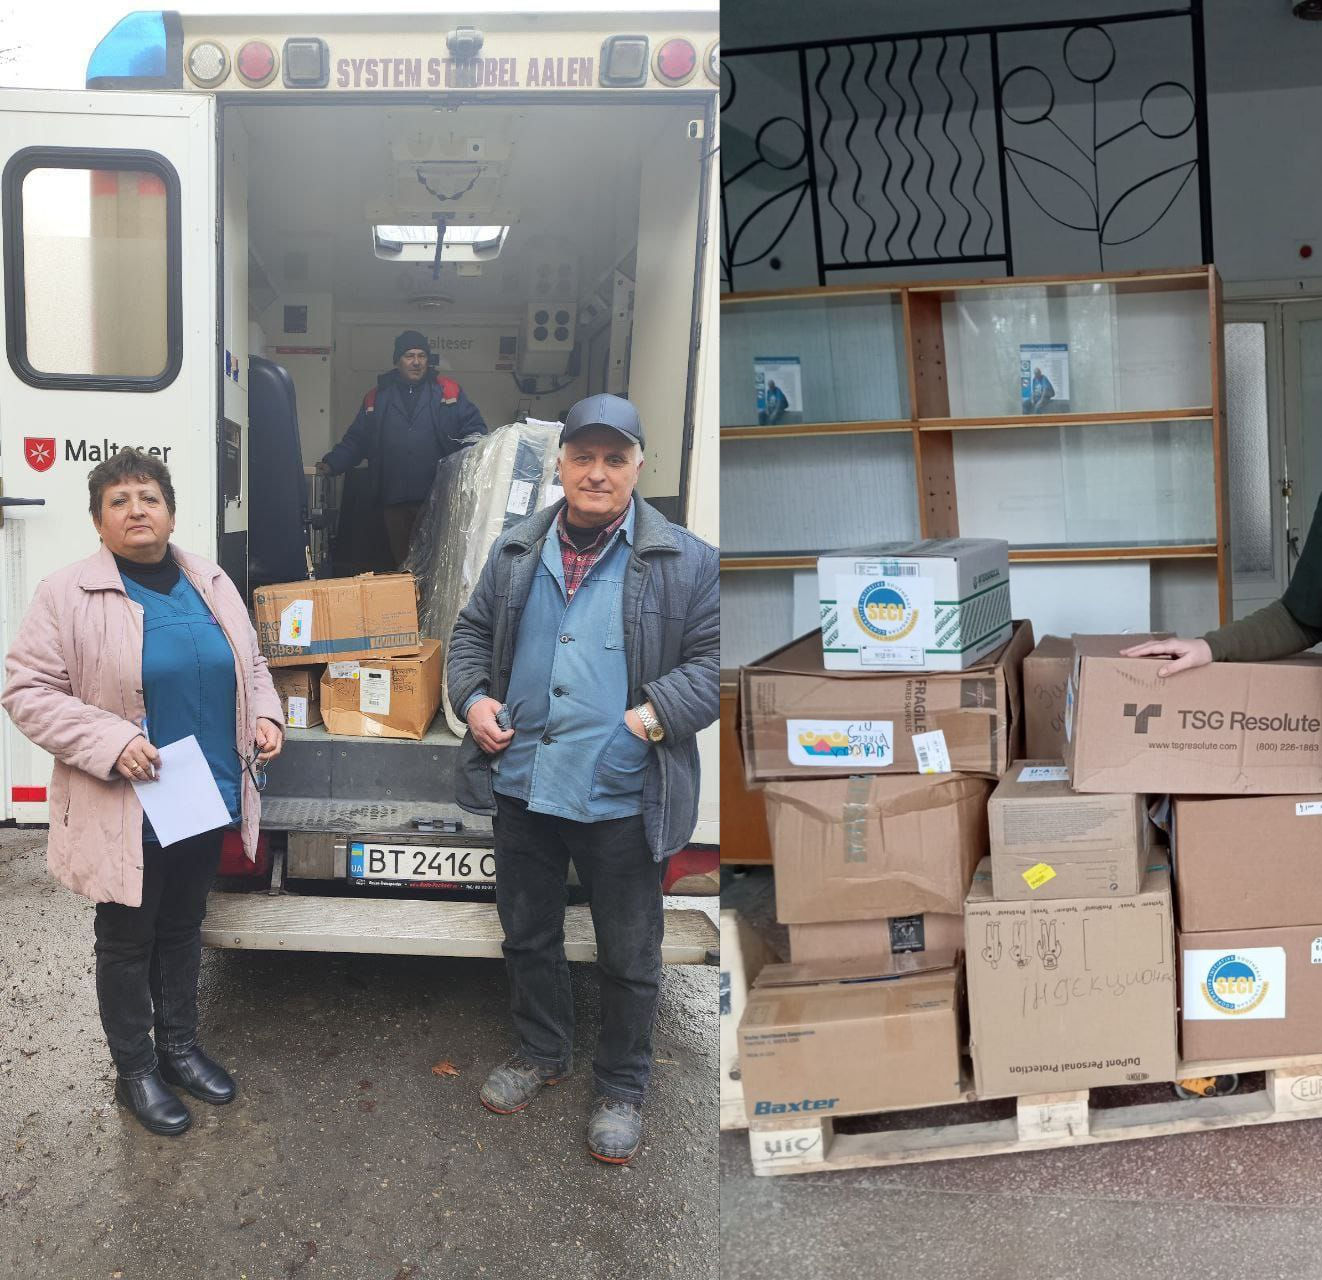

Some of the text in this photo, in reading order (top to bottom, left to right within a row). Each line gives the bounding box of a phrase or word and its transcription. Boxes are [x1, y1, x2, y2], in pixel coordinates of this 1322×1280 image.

[336, 58, 422, 88] SYSTEM
[526, 57, 594, 87] AALEN
[429, 336, 474, 350] alteser
[65, 439, 171, 463] Malter
[867, 602, 905, 621] SECI
[914, 680, 927, 732] FRAGILE
[1178, 710, 1321, 733] TSG Resolute
[1148, 742, 1320, 752] www.tsgresolute.com (800) 226-1863
[351, 864, 362, 873] UA
[369, 849, 405, 873] BT
[412, 851, 472, 877] 2416
[1216, 976, 1254, 994] SECI
[1009, 1057, 1141, 1073] DuPont Personal Protection
[754, 1098, 840, 1115] Baxter
